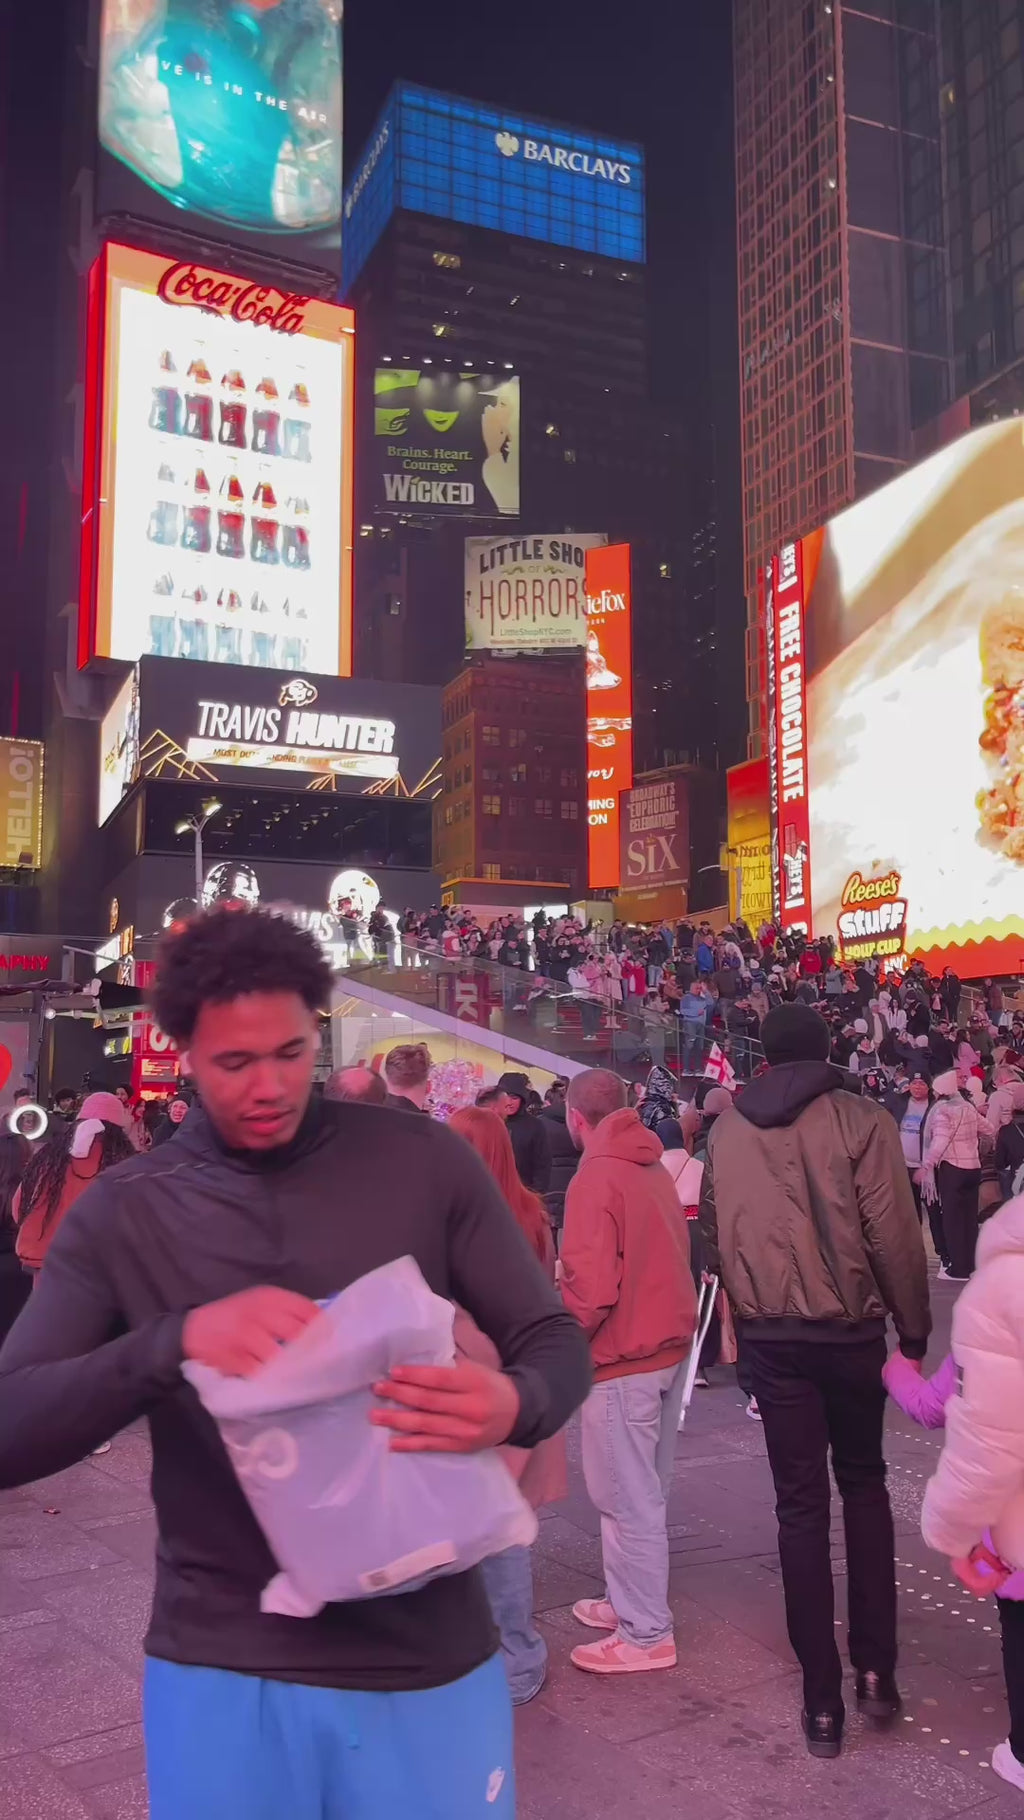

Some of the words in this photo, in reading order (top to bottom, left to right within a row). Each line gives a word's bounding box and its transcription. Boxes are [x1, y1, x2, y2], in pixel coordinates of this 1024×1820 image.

[135, 53, 183, 76] LVE
[195, 72, 213, 86] IS
[224, 82, 243, 95] IN
[255, 91, 287, 110] THE
[298, 107, 327, 123] AIR
[524, 140, 631, 184] BARCLAYS
[158, 262, 310, 335] Coca-Cola
[387, 446, 432, 458] Brains.
[434, 449, 473, 460] Heart.
[403, 459, 458, 474] Courage.
[480, 539, 544, 574] LITTLE
[779, 601, 800, 662] FREE
[198, 701, 281, 743] TRAVIS
[286, 711, 396, 753] HUNTER
[779, 663, 804, 802] CHOCOLATE
[6, 747, 34, 859] HELLO!
[629, 782, 675, 802] BROADWAY'S
[842, 873, 899, 905] Reese's
[877, 938, 901, 956] CUP
